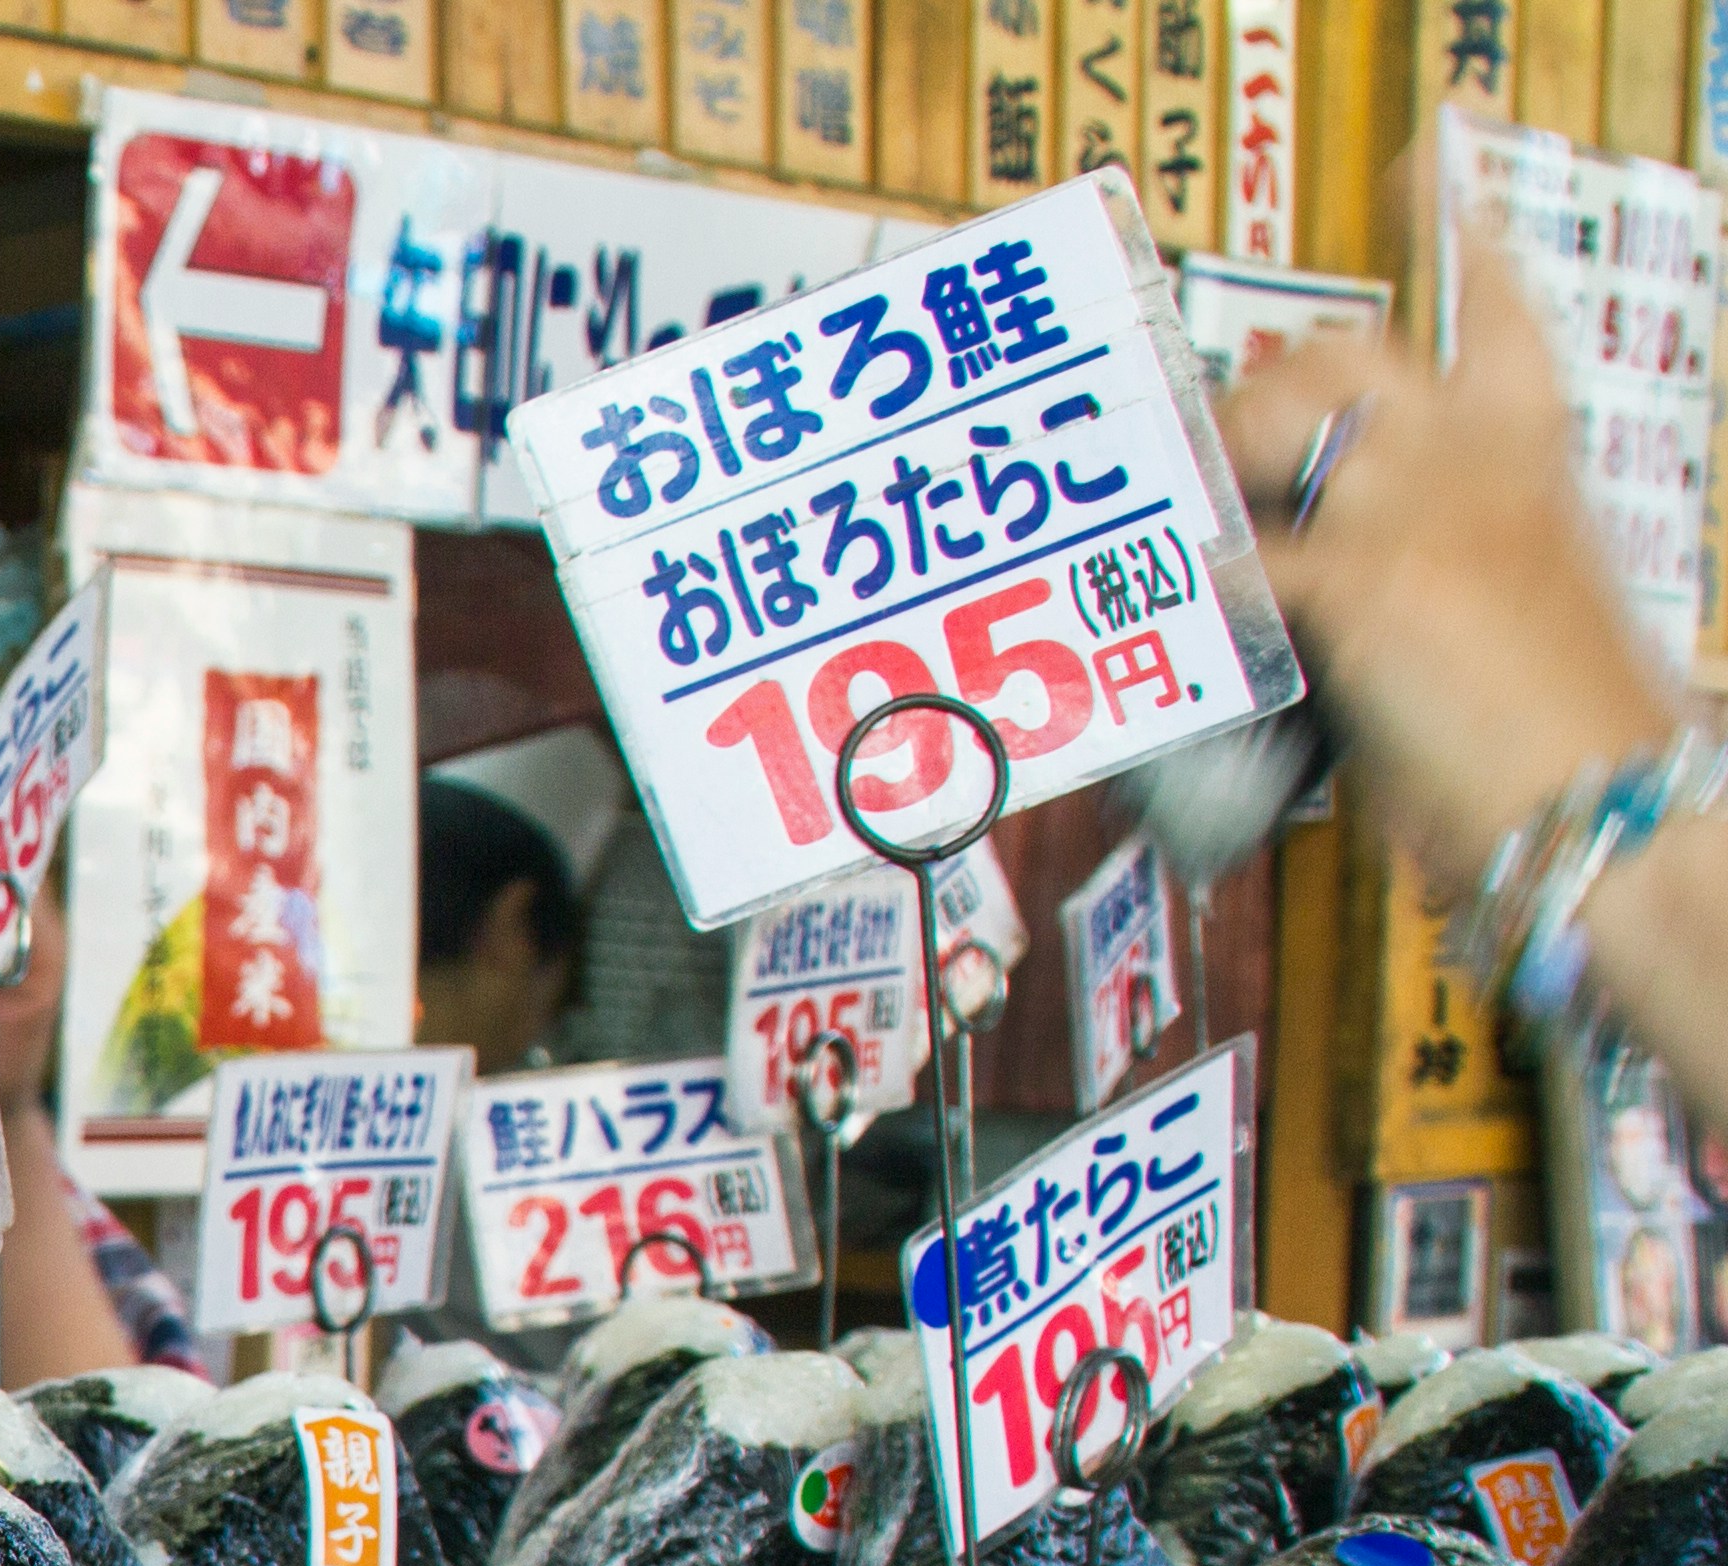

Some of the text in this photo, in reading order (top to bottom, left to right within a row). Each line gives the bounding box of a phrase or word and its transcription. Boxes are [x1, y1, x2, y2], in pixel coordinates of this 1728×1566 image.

[581, 238, 1072, 520] おぼろ鮭
[640, 392, 1129, 668] おぼろたらこ
[705, 524, 1196, 847] 195円 (税込)
[1154, 1199, 1220, 1296] (税込)
[322, 1426, 380, 1565] 親子
